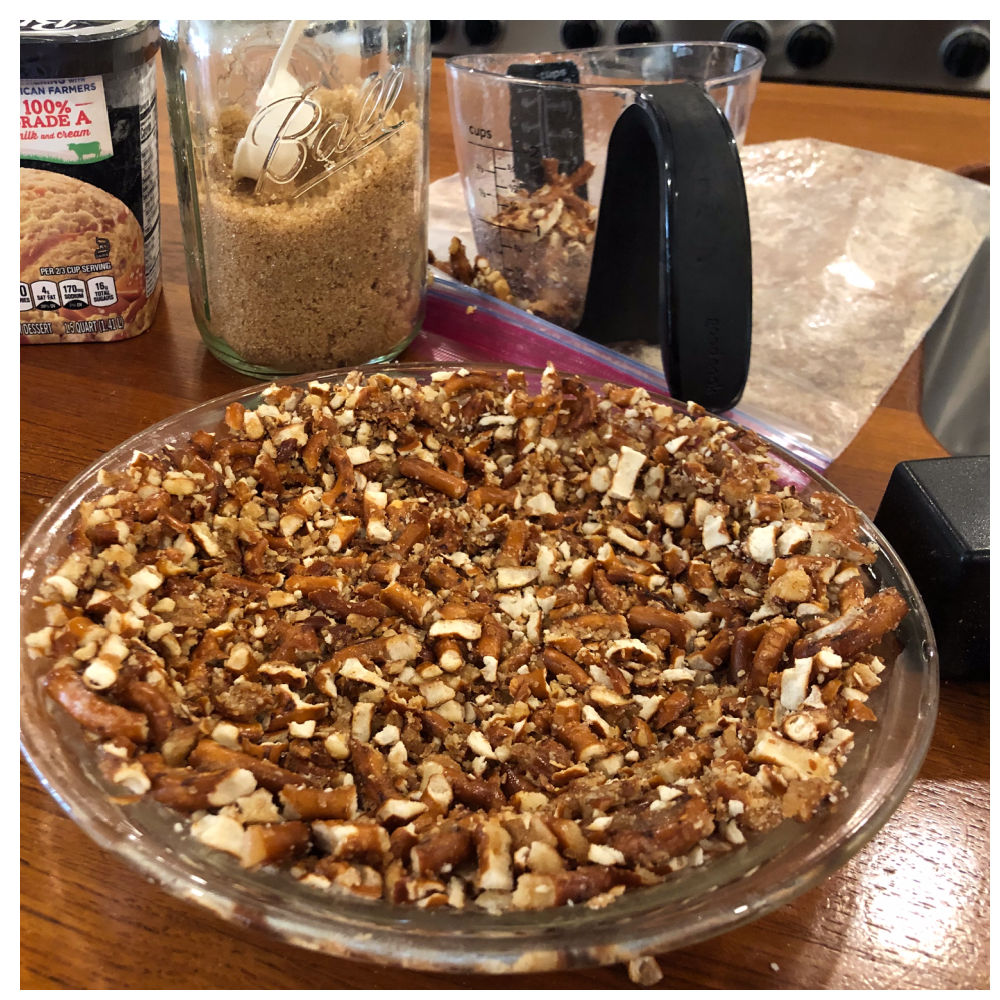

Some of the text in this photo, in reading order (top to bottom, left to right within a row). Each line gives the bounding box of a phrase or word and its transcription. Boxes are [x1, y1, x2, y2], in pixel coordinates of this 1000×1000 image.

[48, 82, 96, 94] FARMERS
[23, 98, 72, 115] 100%
[20, 110, 92, 128] RADE A
[41, 132, 55, 140] and
[56, 129, 91, 139] cream
[252, 66, 406, 194] Ball
[469, 125, 492, 139] cups
[40, 267, 55, 275] PER
[66, 265, 81, 274] CUP
[81, 262, 112, 273] SERVING
[23, 322, 53, 335] DESSERT
[75, 320, 97, 333] QUART
